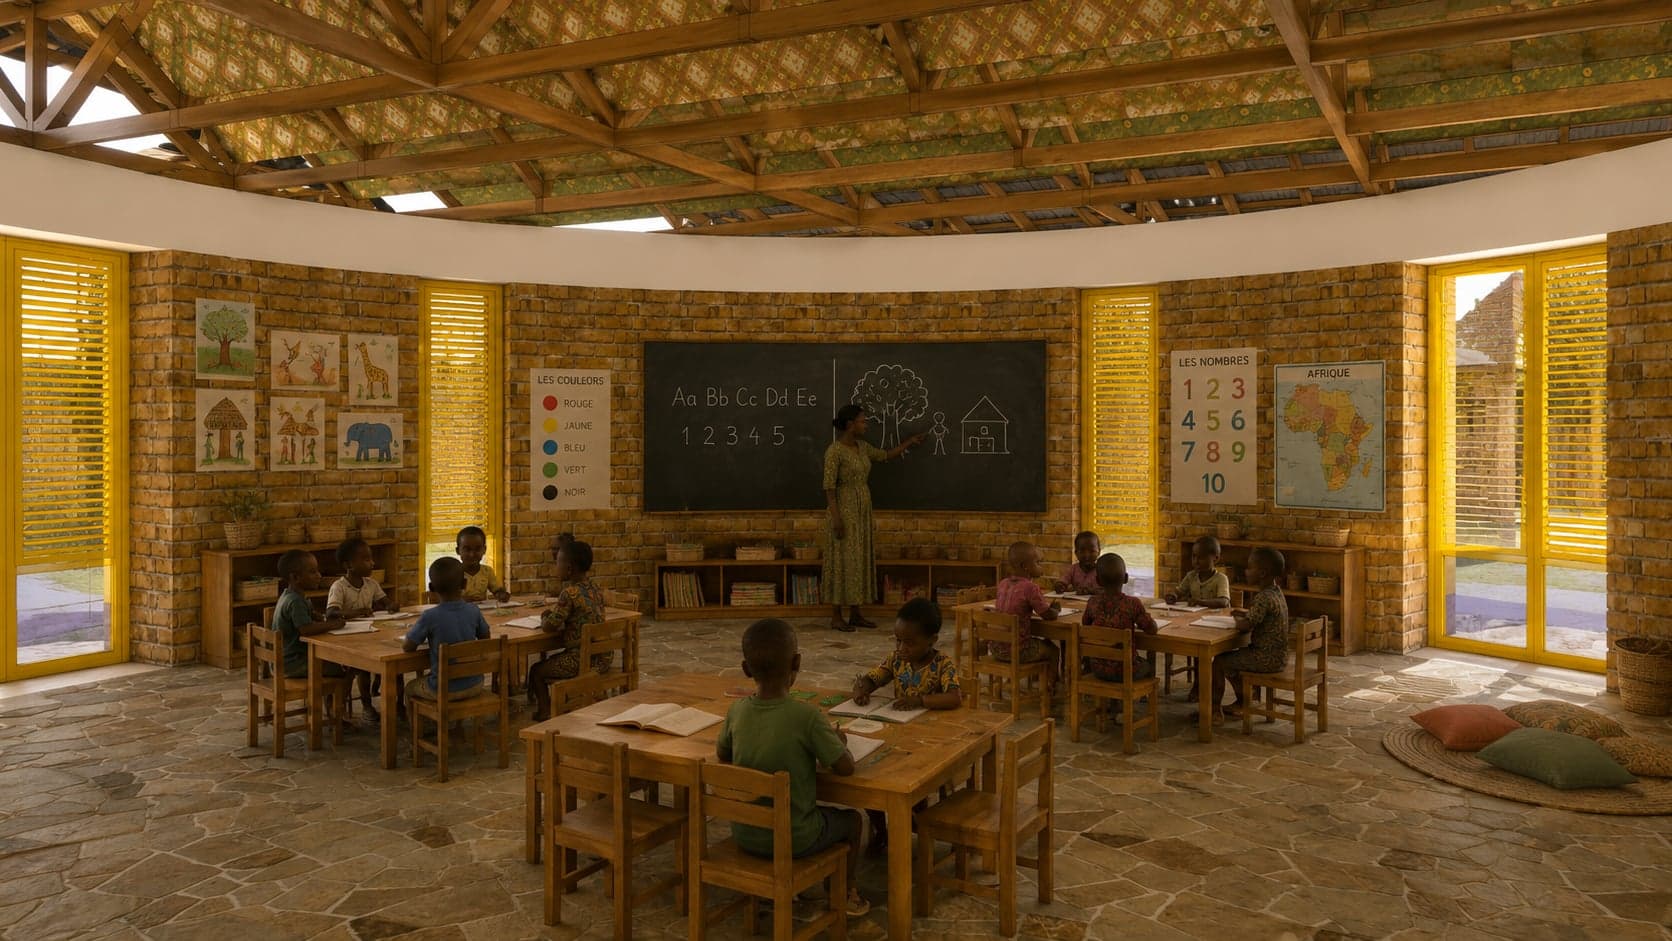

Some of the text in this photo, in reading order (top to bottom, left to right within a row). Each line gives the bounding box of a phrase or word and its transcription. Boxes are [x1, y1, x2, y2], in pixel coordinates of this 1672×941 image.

[1179, 356, 1249, 367] LES NOMBRES
[1307, 368, 1351, 378] AFRIQUE
[537, 375, 554, 385] LES
[1183, 377, 1246, 400] 1 2 3
[671, 386, 817, 407] Aa Bb Cc Dd Ee
[564, 399, 593, 409] ROUGE
[564, 421, 593, 430] JAUNE
[1181, 410, 1246, 431] 4 5 6
[682, 425, 785, 445] 1 2 3 4 5
[564, 443, 586, 452] BLEU
[1181, 441, 1246, 463] 7 8 9
[564, 465, 586, 474] VERT
[1201, 472, 1226, 494] 10
